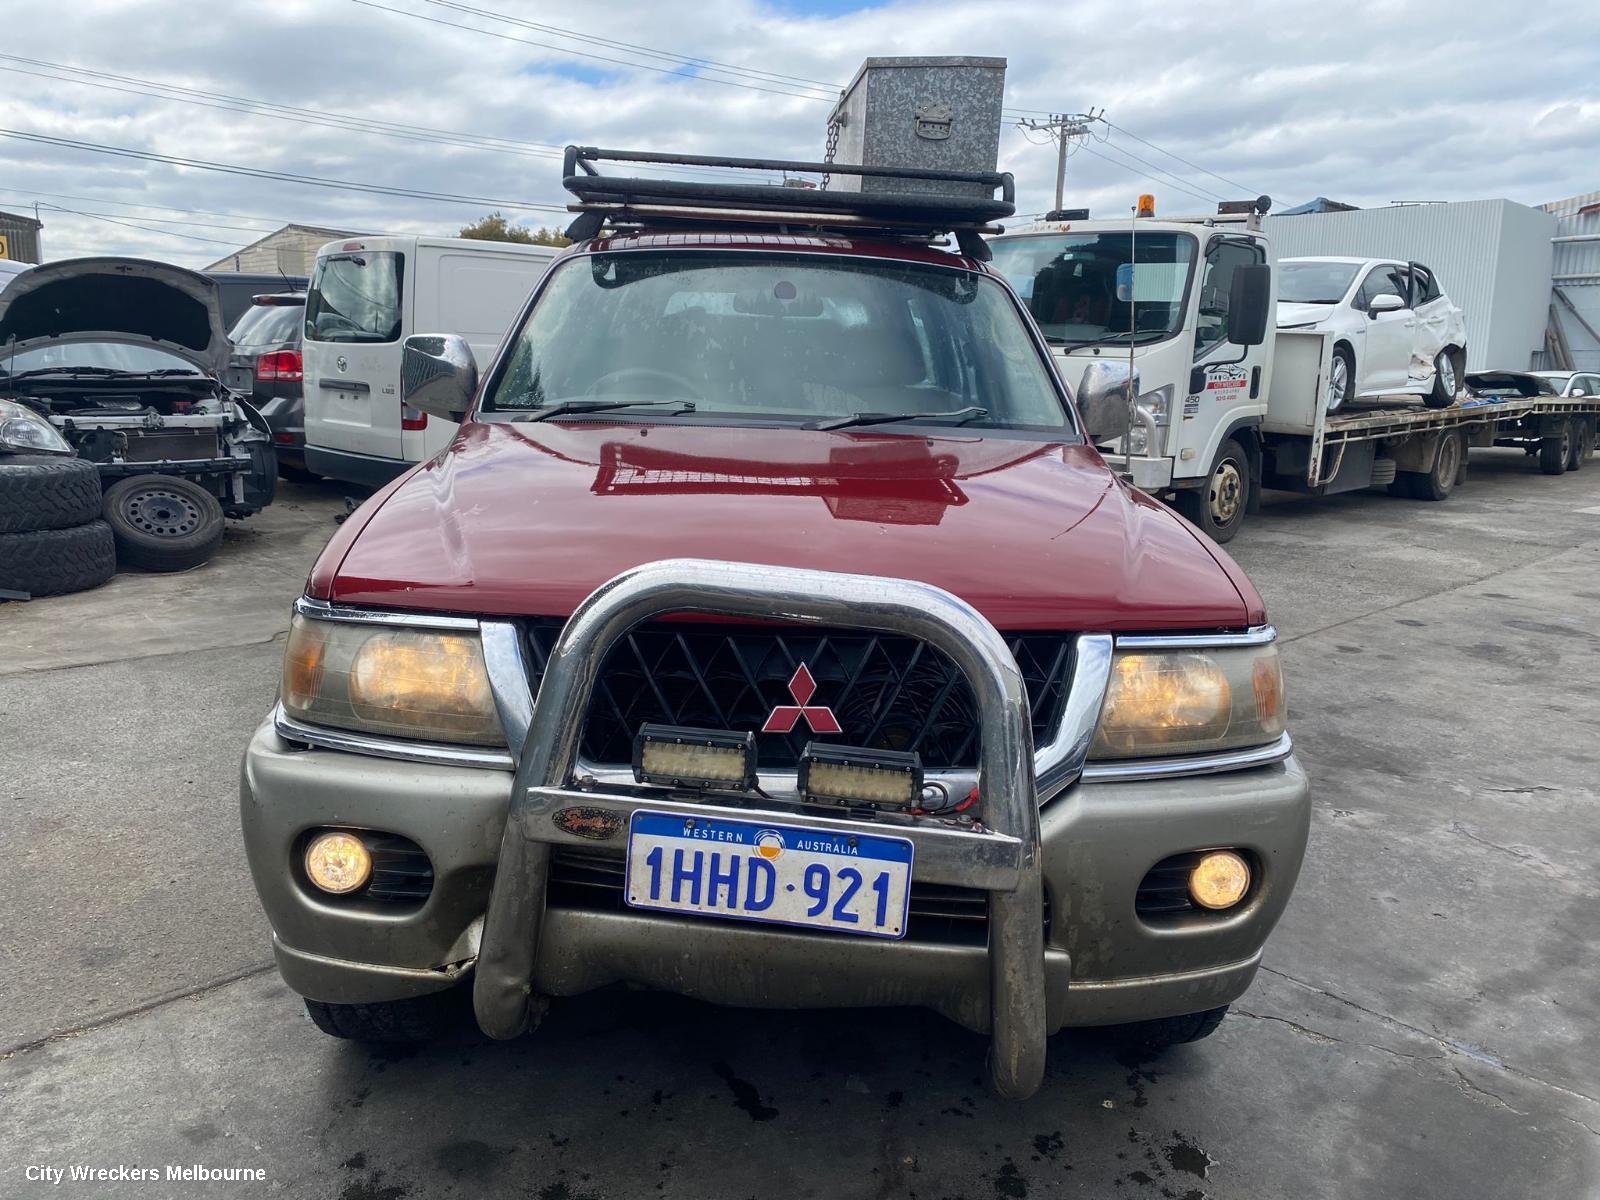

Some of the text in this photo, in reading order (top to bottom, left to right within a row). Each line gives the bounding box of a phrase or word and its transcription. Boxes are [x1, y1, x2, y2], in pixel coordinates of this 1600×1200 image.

[1185, 395, 1200, 404] 450
[683, 827, 858, 855] WESTERN AUSTRALIA
